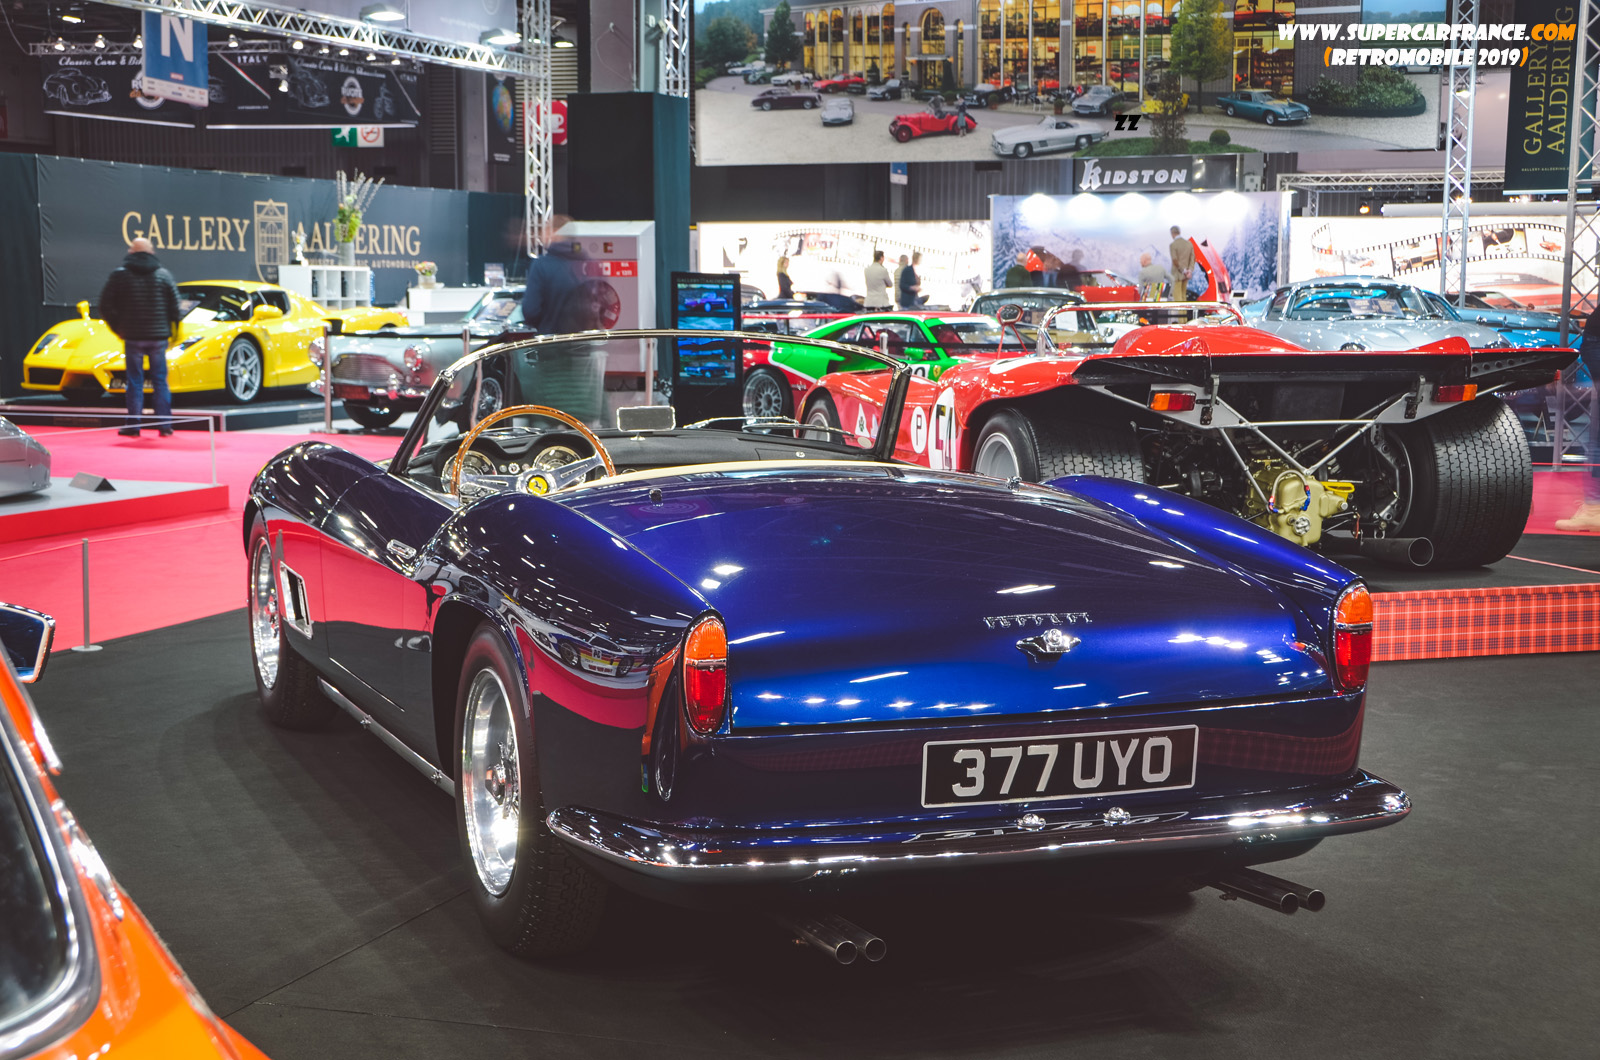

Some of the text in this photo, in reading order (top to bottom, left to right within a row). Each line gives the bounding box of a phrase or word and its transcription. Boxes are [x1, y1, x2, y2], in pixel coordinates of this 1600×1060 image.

[161, 0, 194, 63] N
[237, 55, 269, 64] ITALY
[1523, 40, 1549, 155] GALLERY
[1546, 5, 1575, 155] AALDERIG
[121, 210, 421, 256] GALLERY AALERING
[952, 735, 1173, 798] 377 UYO
